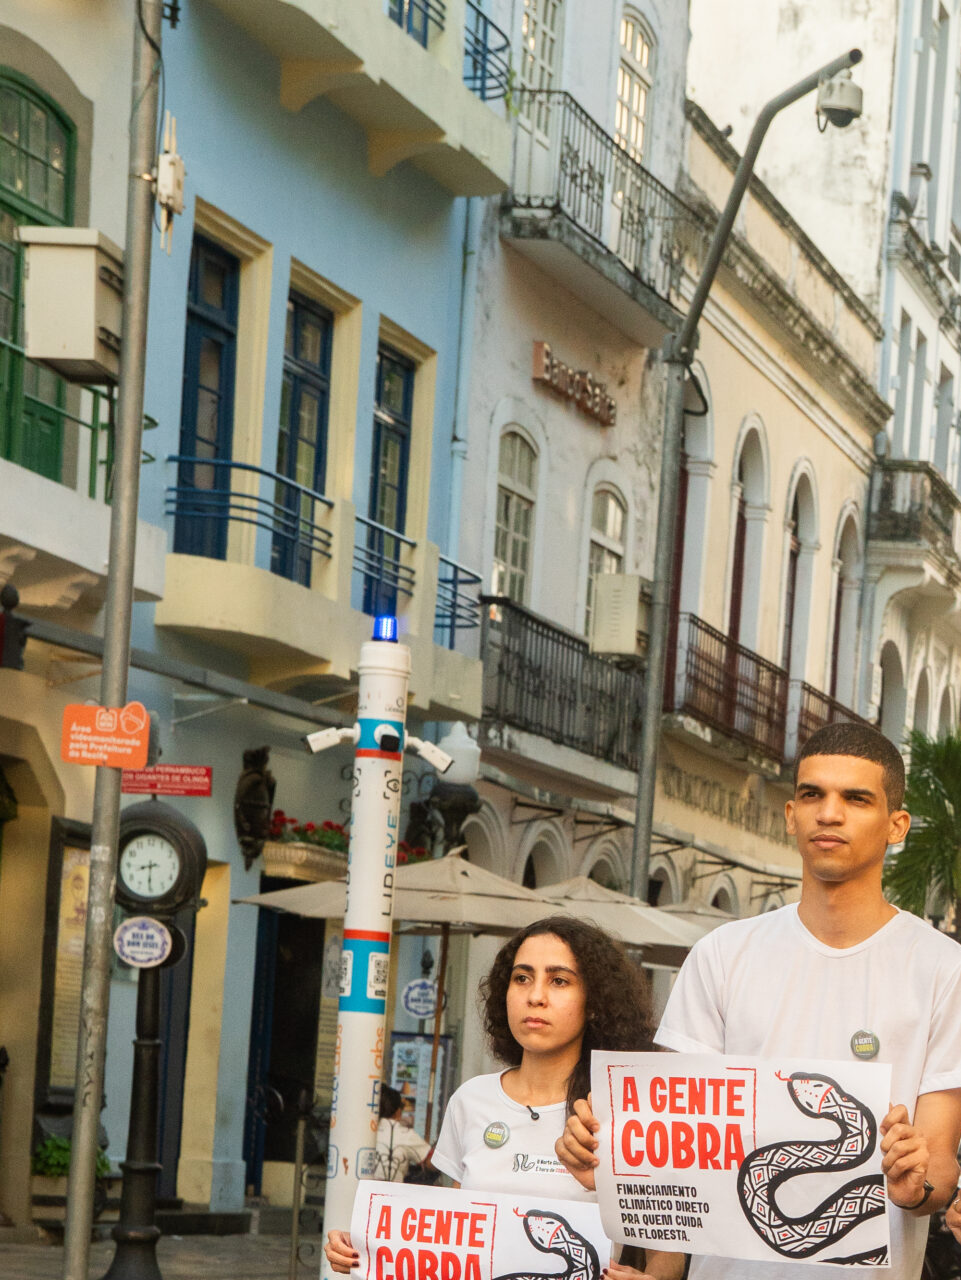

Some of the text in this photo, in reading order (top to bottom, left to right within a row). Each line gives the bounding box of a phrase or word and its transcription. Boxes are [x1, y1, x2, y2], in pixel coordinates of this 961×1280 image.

[382, 814, 397, 916] LIDEYE
[623, 1077, 745, 1116] A GENTE
[622, 1120, 745, 1170] COBRA
[617, 1184, 697, 1197] FINANCIAMENTO
[619, 1197, 709, 1213] CLIMÁTICO DIRETO
[376, 1206, 486, 1247] A GENTE
[622, 1213, 702, 1228] PRA QUEM CUIDA
[624, 1227, 690, 1242] DA FLORESTA.
